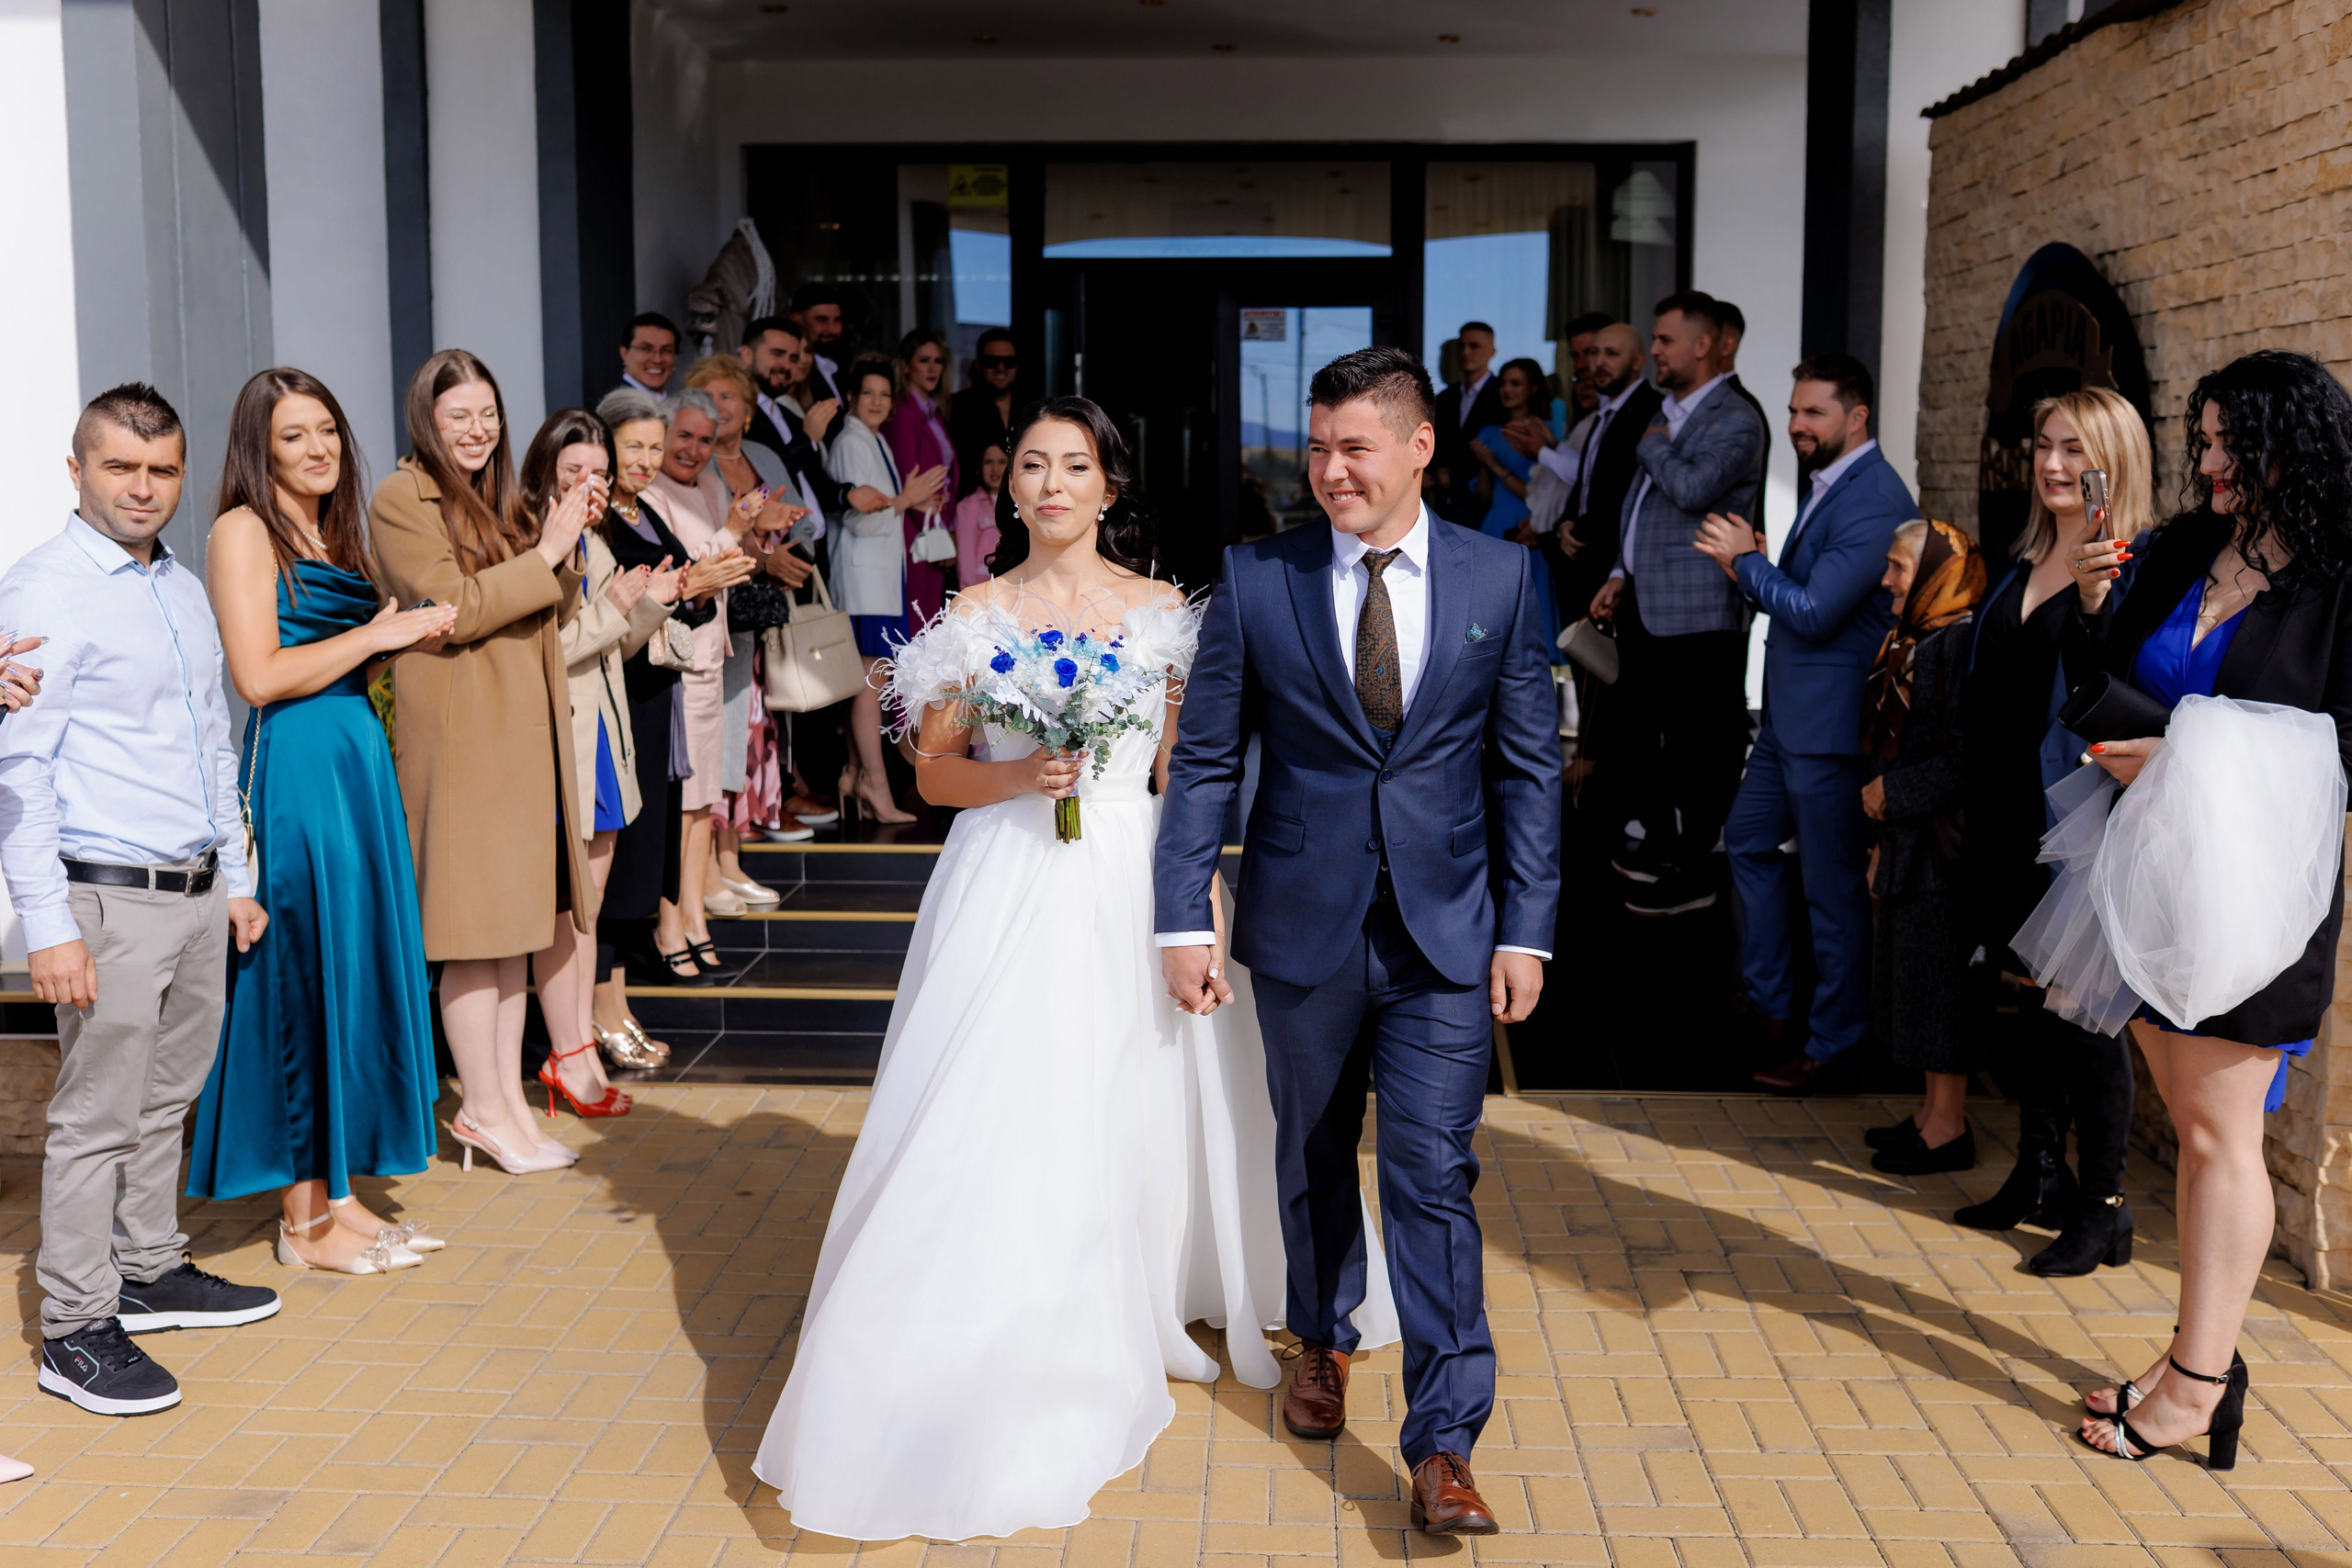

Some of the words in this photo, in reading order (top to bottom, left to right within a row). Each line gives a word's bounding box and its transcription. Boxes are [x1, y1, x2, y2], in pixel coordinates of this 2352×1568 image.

[2009, 300, 2086, 377] AGAPIA
[89, 1320, 103, 1331] FILA
[74, 1355, 89, 1372] FILA
